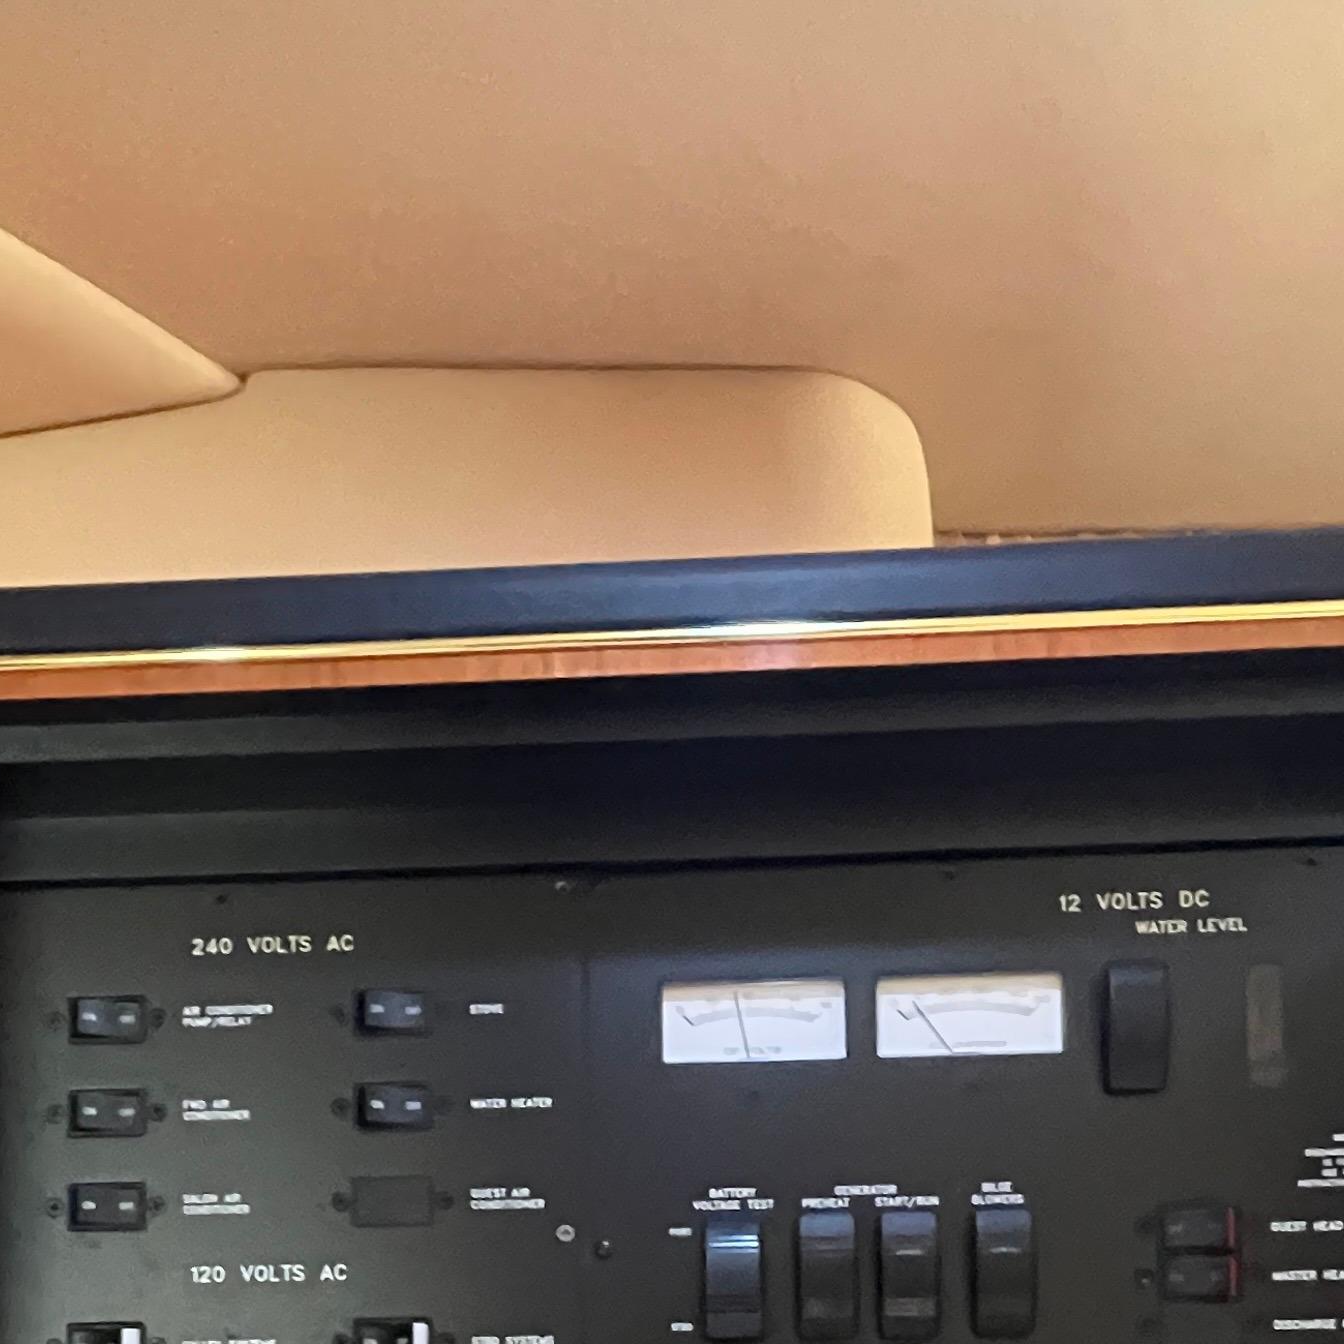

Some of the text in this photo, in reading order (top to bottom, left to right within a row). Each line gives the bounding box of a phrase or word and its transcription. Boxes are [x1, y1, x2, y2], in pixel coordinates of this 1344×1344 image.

[1059, 889, 1210, 913] 12 VOLTS DC
[1135, 917, 1248, 934] WATER LEVEL
[191, 934, 354, 956] 240 VOLTS AC
[190, 1263, 347, 1284] 120 VOLTS AC
